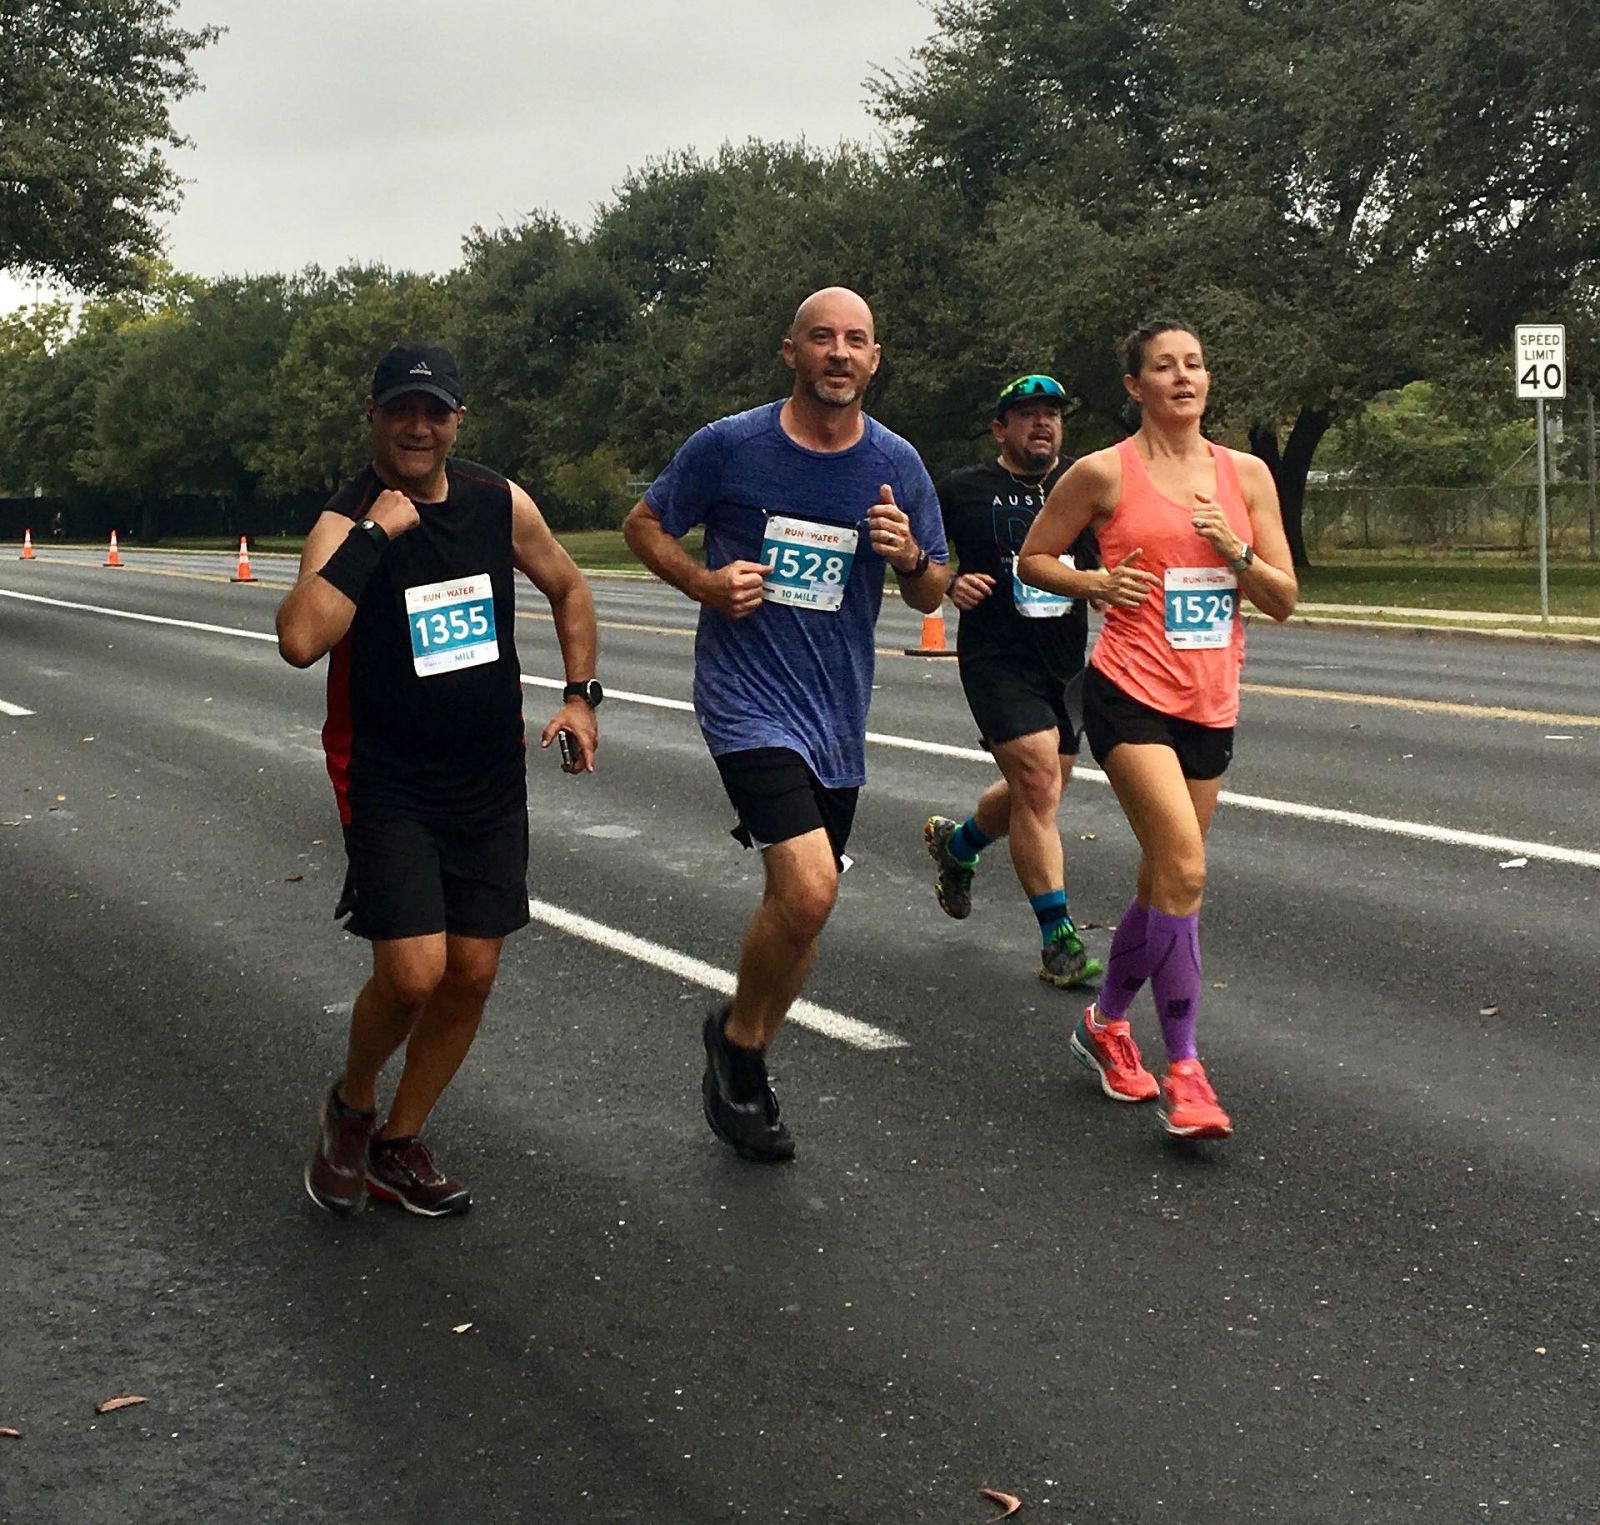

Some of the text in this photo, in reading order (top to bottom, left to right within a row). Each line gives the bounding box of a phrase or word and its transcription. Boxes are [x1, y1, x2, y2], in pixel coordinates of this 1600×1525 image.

[1520, 335, 1560, 345] SPEED
[1525, 350, 1556, 360] LIMIT
[1520, 364, 1562, 389] 40
[784, 528, 839, 543] RUN WATER
[767, 547, 843, 585] 1528
[423, 586, 475, 603] RUN WATER
[781, 589, 818, 602] 10 MILE
[1171, 595, 1233, 623] 1529
[416, 606, 488, 648] 1355
[455, 650, 475, 662] MILE
